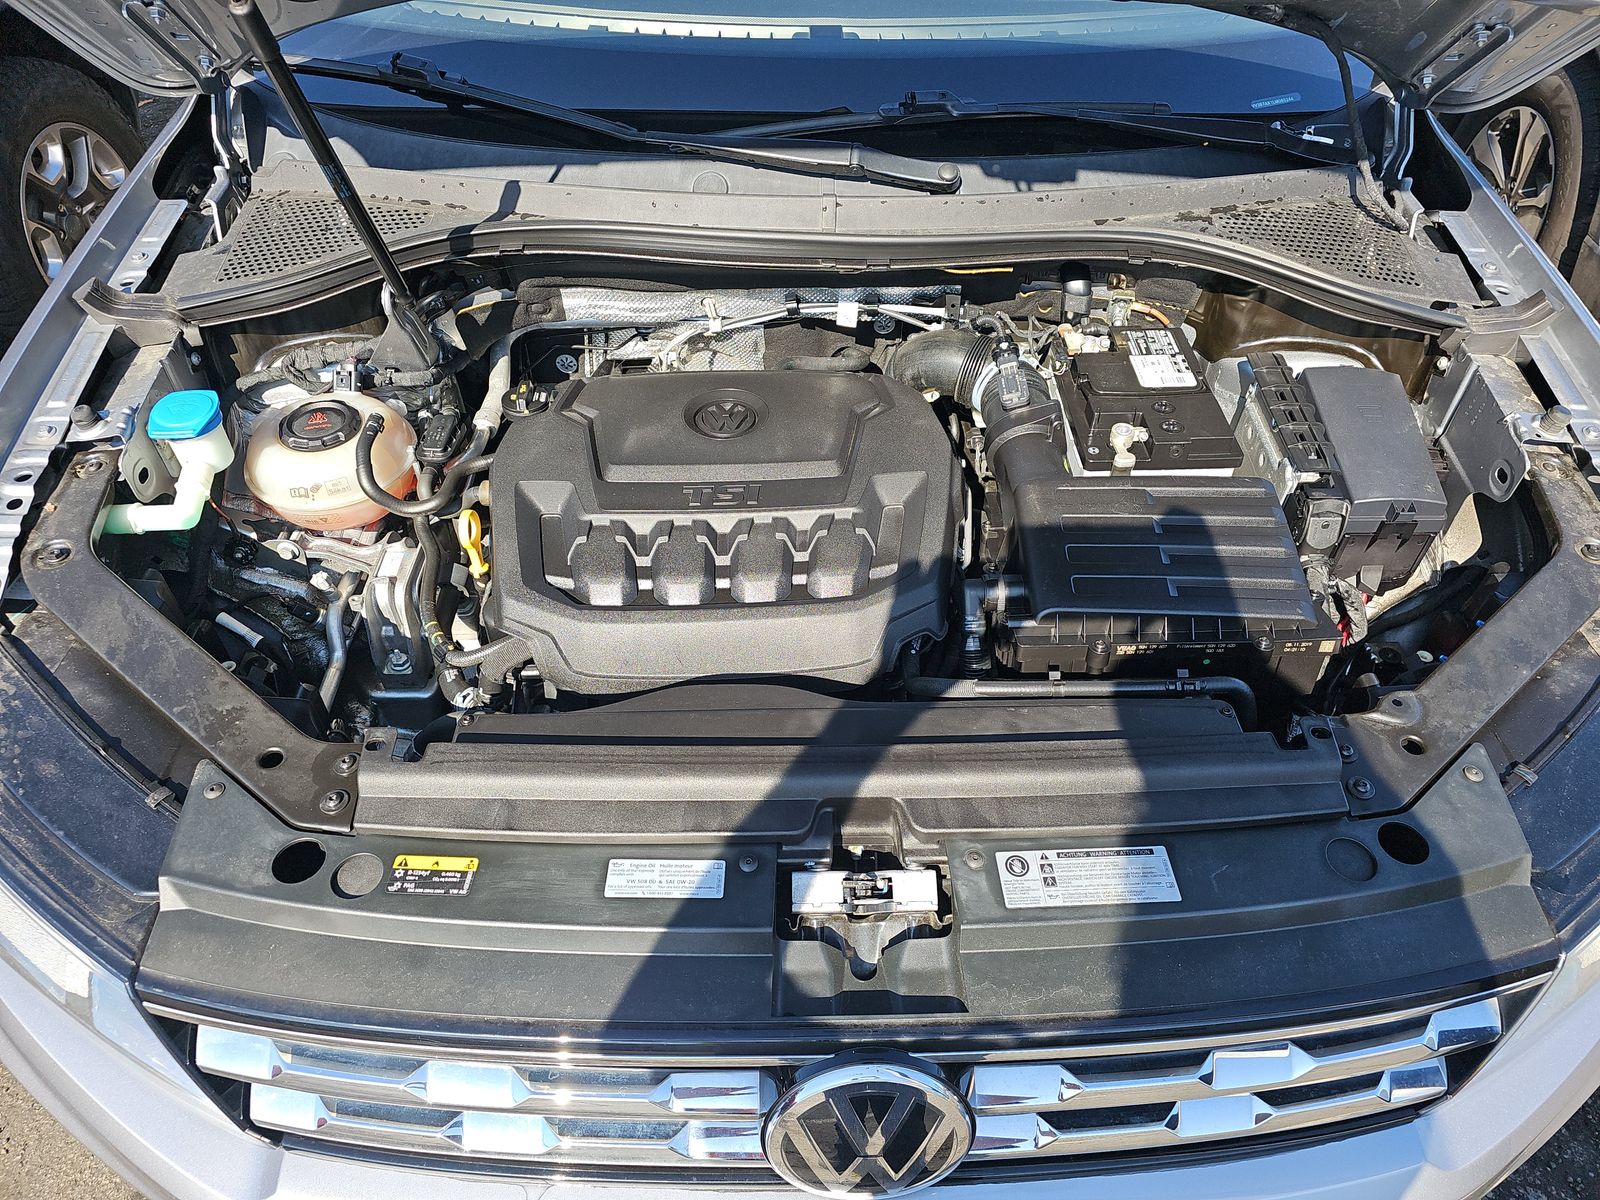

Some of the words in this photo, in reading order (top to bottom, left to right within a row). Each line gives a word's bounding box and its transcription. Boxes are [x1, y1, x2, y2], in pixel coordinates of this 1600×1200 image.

[693, 399, 758, 440] VW
[682, 484, 762, 506] TSI
[768, 1075, 969, 1198] VW
